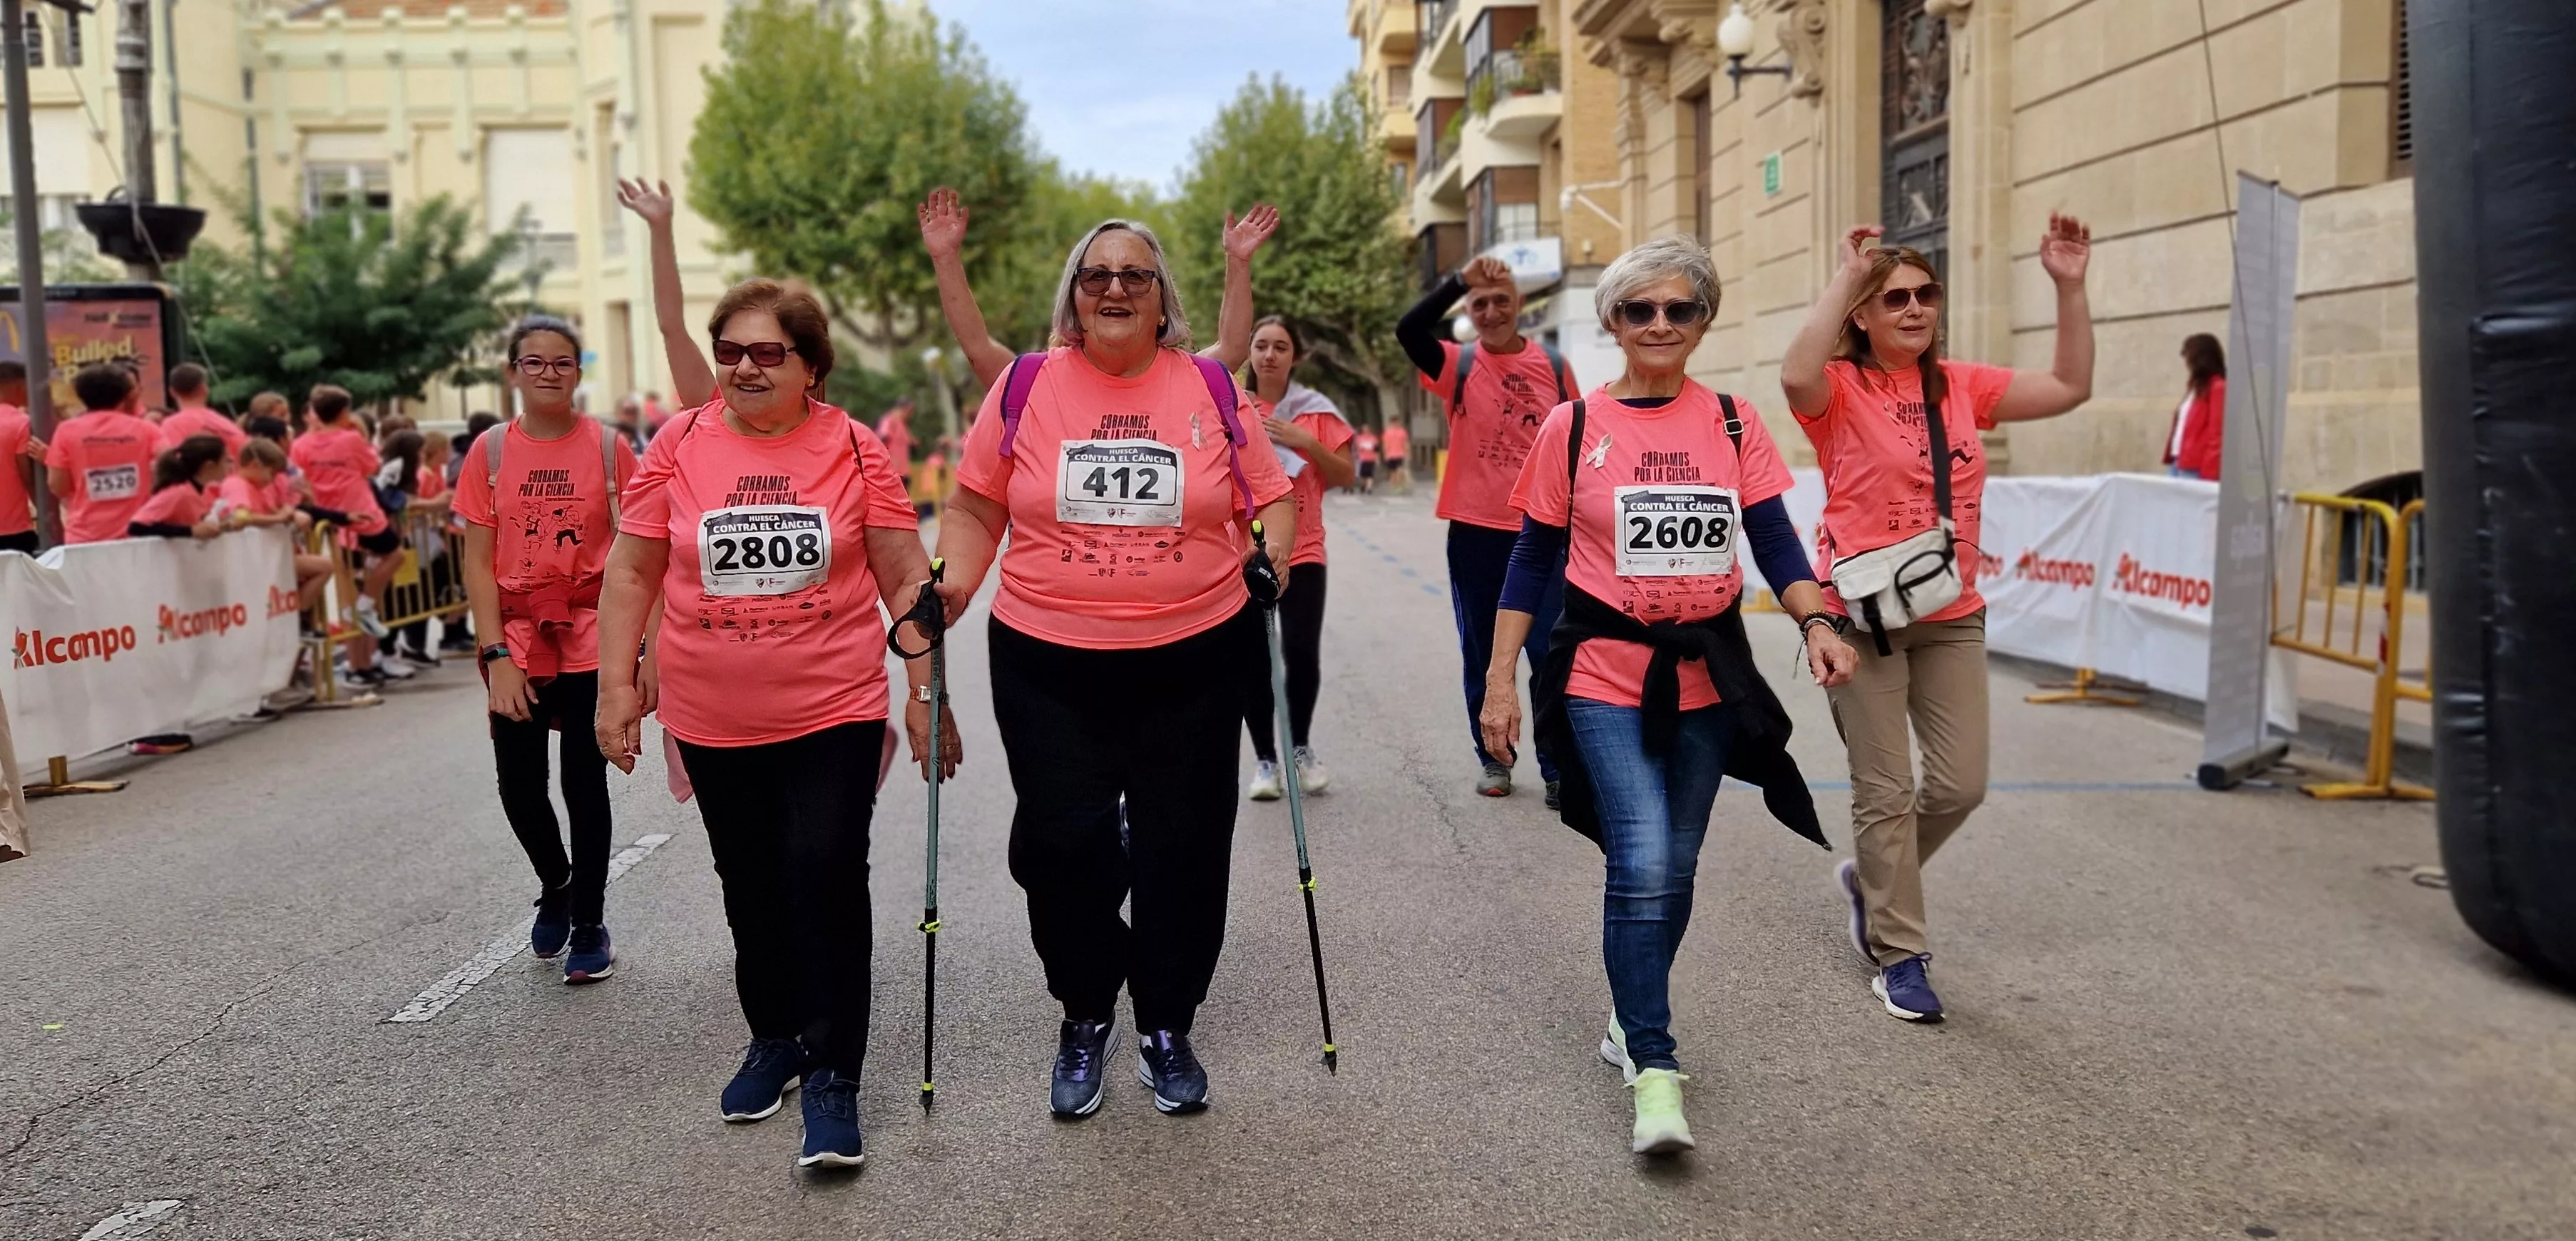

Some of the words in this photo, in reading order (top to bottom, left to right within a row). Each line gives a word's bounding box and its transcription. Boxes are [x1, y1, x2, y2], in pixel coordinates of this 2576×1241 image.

[1100, 414, 1150, 429] CORRAMOS
[1074, 454, 1116, 462] CONTRA
[1132, 453, 1172, 464] CÁNCER
[1642, 451, 1690, 467] CORRAMOS
[528, 470, 569, 484] CORRAMOS
[1635, 467, 1651, 482] POR
[1654, 467, 1663, 482] LA
[1666, 466, 1701, 481] CIENCIA
[518, 484, 535, 496] POR
[535, 484, 543, 496] LA
[545, 483, 575, 496] CIENCIA
[736, 476, 790, 492] CORRAMOS
[1083, 466, 1159, 499] 412
[724, 492, 743, 508] POR
[760, 491, 797, 506] CIENCIA
[1630, 502, 1673, 511] CONTRA
[1689, 501, 1729, 512] CÁNCER
[713, 522, 757, 534] CONTRA
[760, 522, 772, 531] EL
[774, 519, 817, 530] CÁNCER
[1629, 516, 1728, 549] 2608
[712, 533, 820, 571] 2808
[2016, 549, 2095, 591] Alcampo
[2112, 553, 2211, 609] Alcampo
[157, 603, 247, 643] Alcampo
[11, 625, 136, 669] Alcampo
